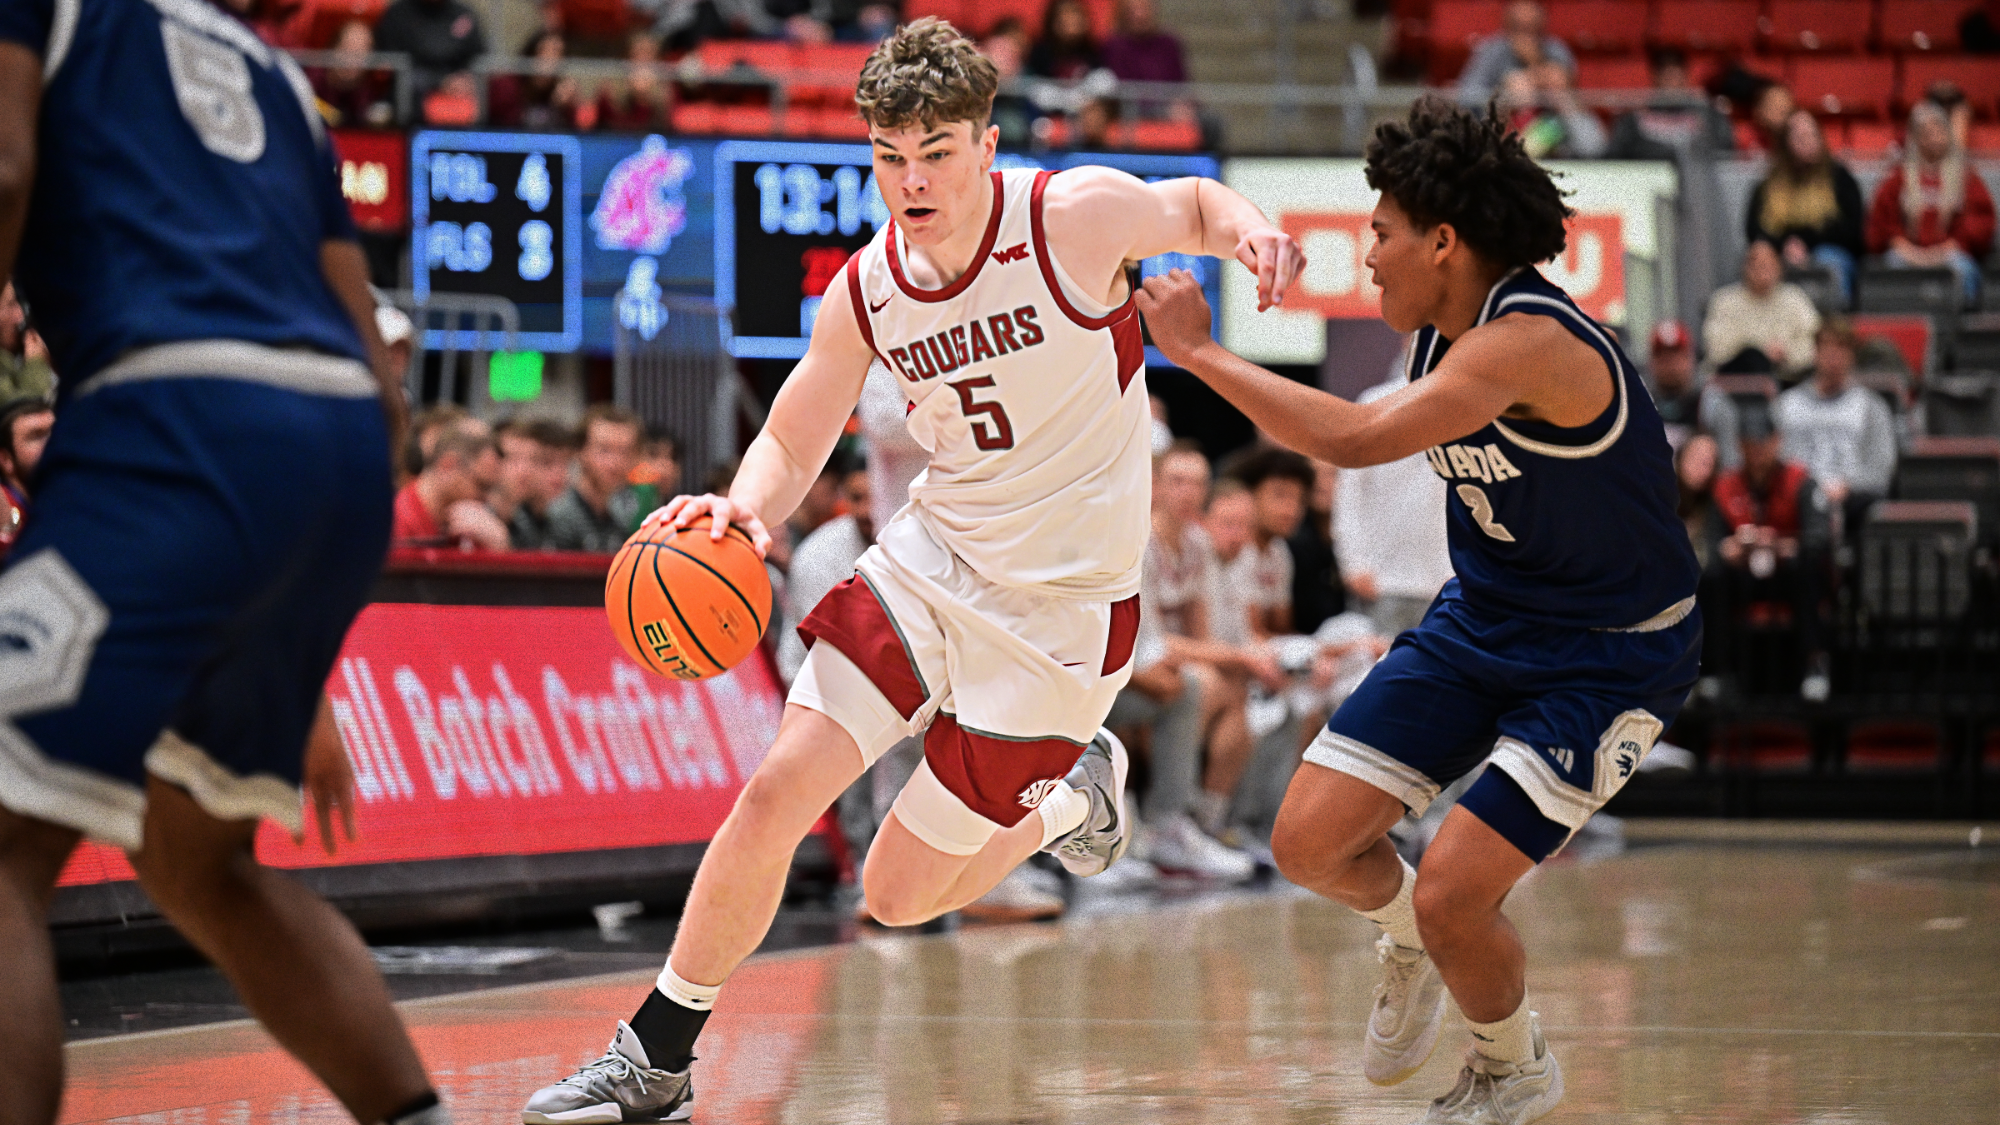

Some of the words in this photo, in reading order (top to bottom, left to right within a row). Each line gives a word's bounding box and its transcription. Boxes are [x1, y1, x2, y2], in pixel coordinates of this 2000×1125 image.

[887, 305, 1044, 382] COUGARS
[944, 374, 1014, 451] 5
[1426, 443, 1522, 484] VADA
[1456, 483, 1516, 542] 2
[392, 664, 563, 800] Batch
